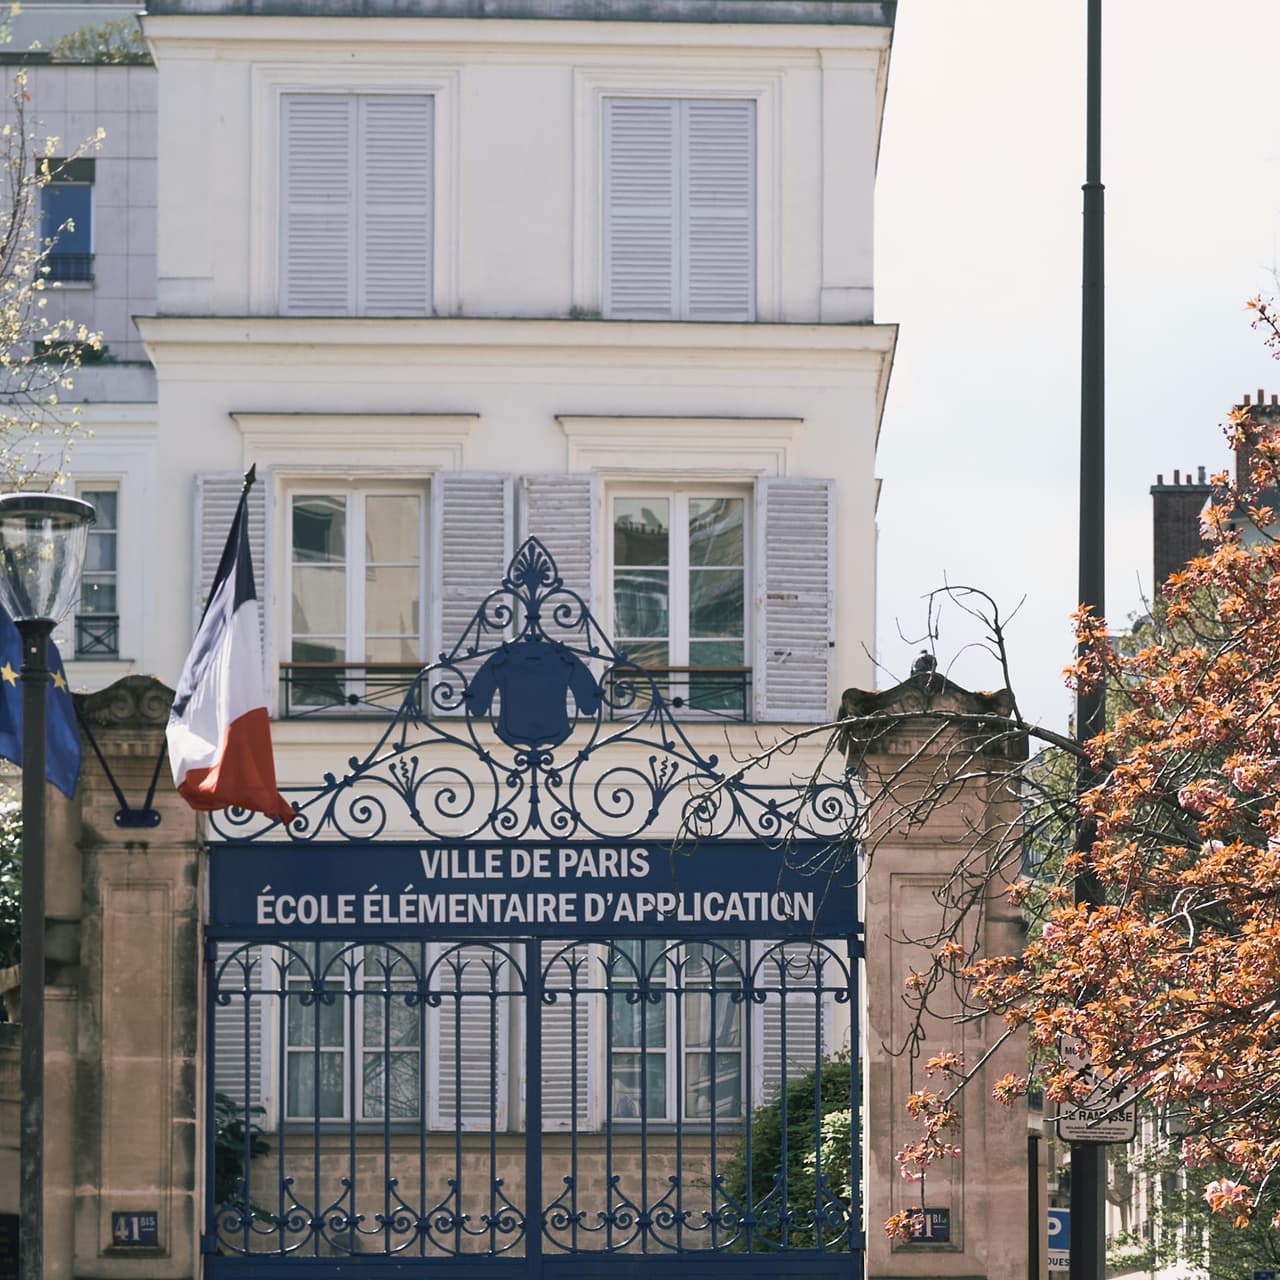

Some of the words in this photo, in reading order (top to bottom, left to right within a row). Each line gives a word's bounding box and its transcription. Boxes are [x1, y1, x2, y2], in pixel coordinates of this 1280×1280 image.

[420, 849, 503, 879] VILLE
[511, 849, 551, 878] DE
[558, 848, 650, 878] PARIS
[256, 884, 356, 924] ÉCOLE
[363, 884, 577, 924] ÉLÉMENTAIRE
[585, 892, 814, 922] D’APPLICATION
[115, 1216, 140, 1240] 41
[140, 1216, 155, 1226] BIS
